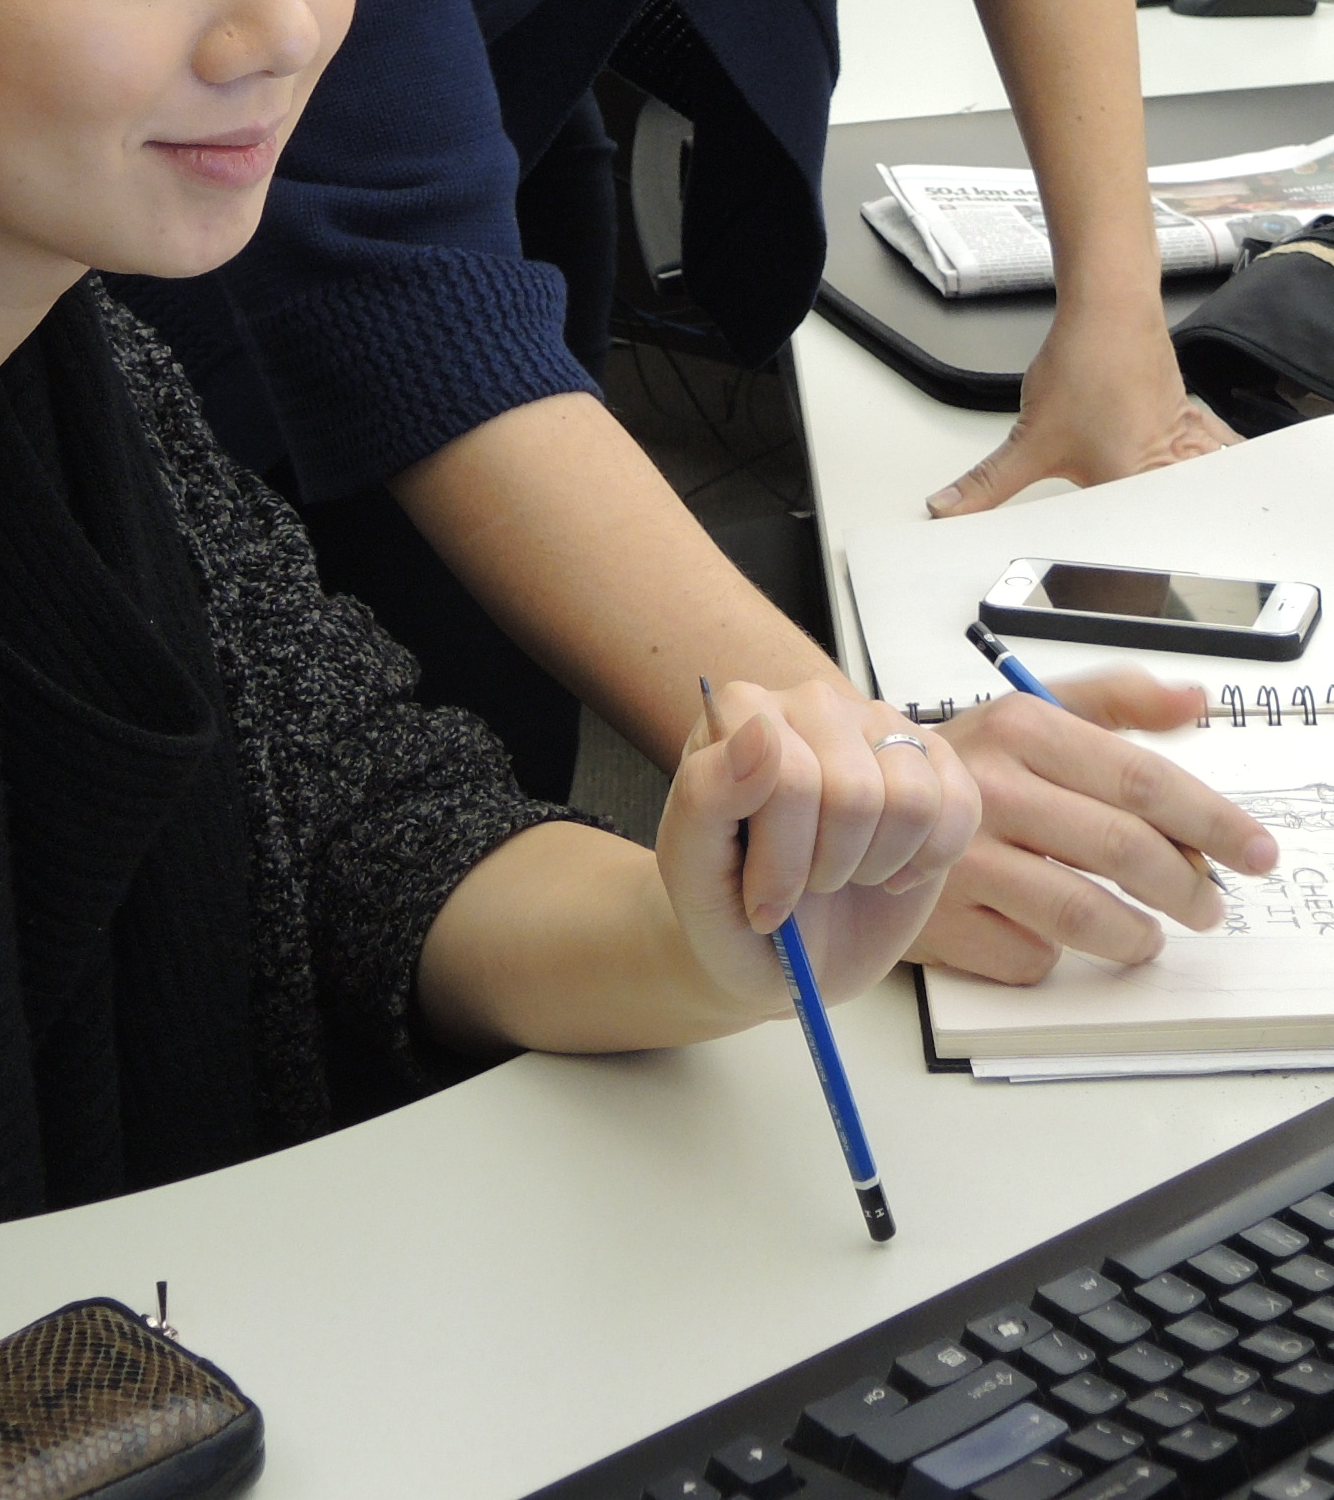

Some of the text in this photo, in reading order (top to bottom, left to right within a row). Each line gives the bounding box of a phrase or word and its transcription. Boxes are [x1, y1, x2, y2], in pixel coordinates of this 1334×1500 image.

[924, 186, 970, 197] 50.1
[971, 186, 1009, 197] km
[1267, 905, 1301, 930] IT
[874, 1207, 885, 1219] H
[1228, 1263, 1251, 1278] M
[1080, 1277, 1098, 1291] Alt
[1260, 1297, 1282, 1312] K
[1233, 1370, 1250, 1384] P
[863, 1388, 885, 1405] Ctrl
[967, 1379, 993, 1399] Shift
